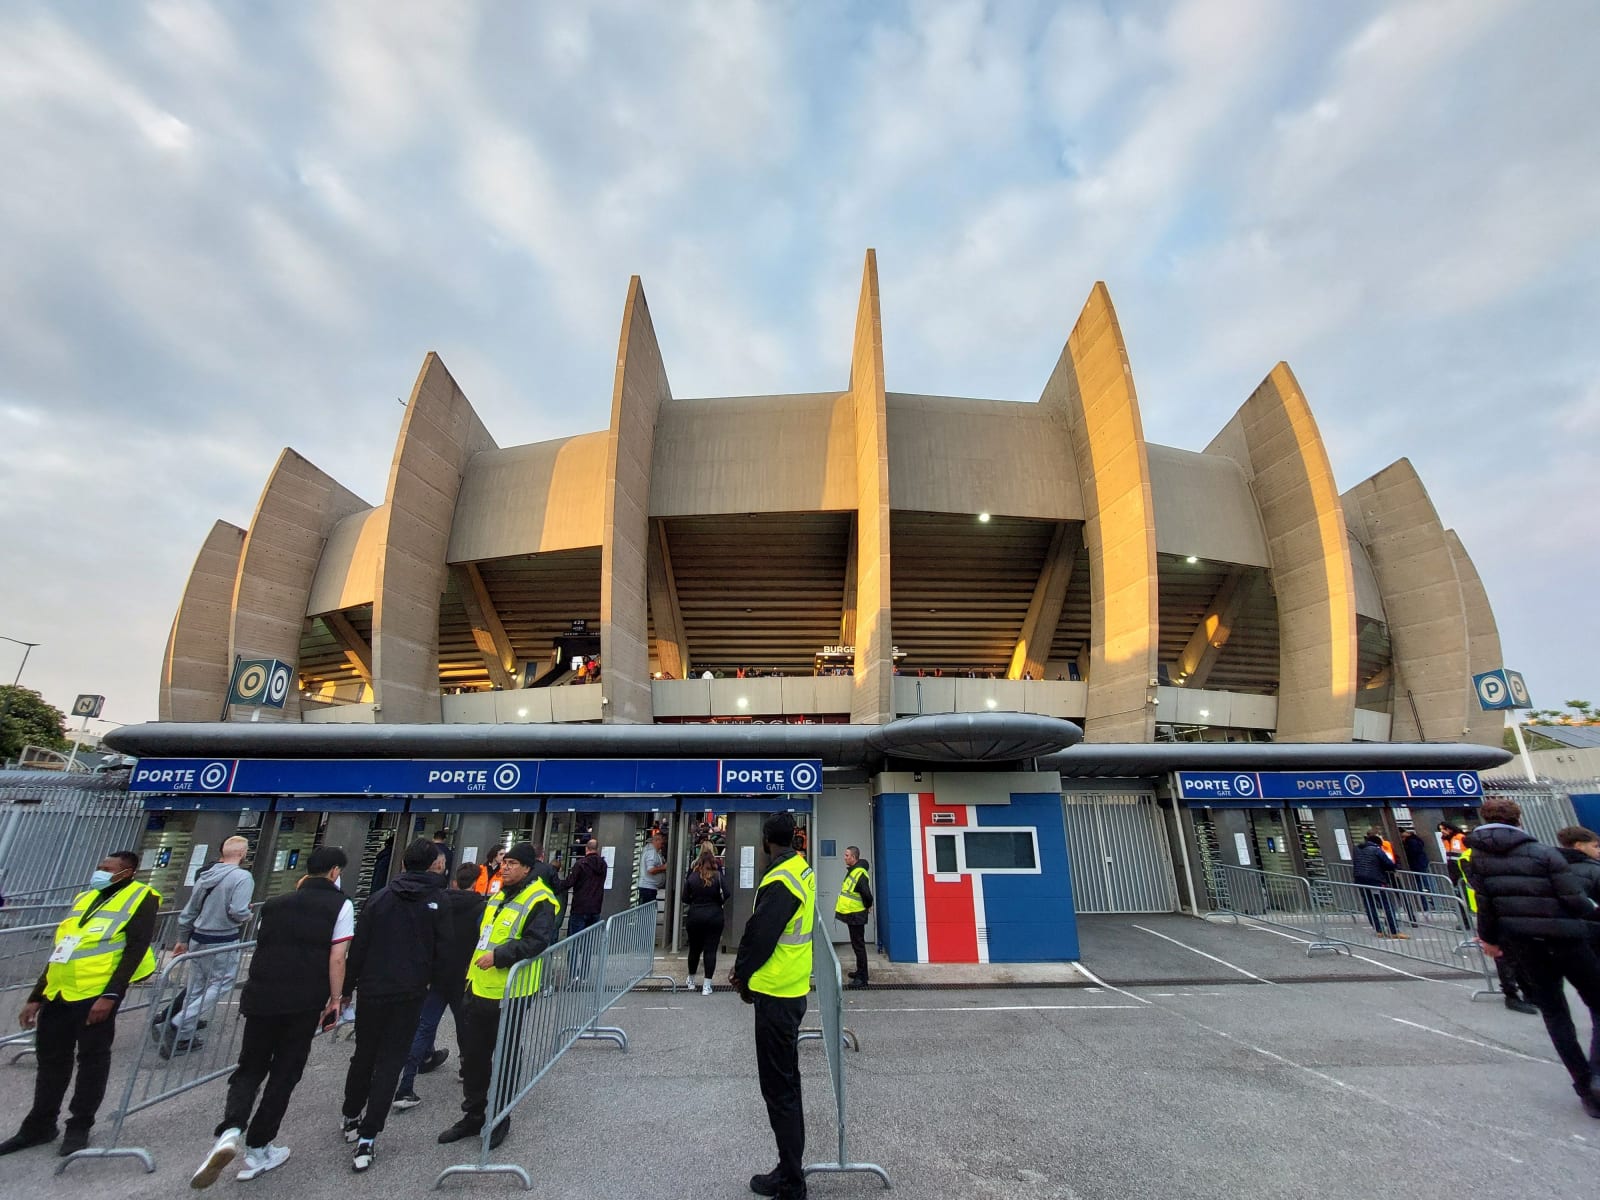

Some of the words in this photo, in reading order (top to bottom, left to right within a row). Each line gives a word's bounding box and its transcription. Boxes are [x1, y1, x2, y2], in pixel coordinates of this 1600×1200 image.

[244, 671, 261, 691] O
[274, 675, 285, 694] O
[1513, 680, 1523, 696] P
[1485, 682, 1499, 698] P
[136, 769, 196, 782] PORTE
[206, 769, 221, 783] O
[428, 770, 488, 783] PORTE
[499, 769, 515, 784] O
[726, 770, 785, 783] PORTE
[796, 769, 812, 784] O
[1185, 780, 1231, 790] PORTE
[1239, 779, 1250, 791] P
[1296, 780, 1342, 790] PORTE
[1348, 778, 1360, 791] P
[1410, 778, 1455, 789] PORTE
[1461, 778, 1473, 790] P
